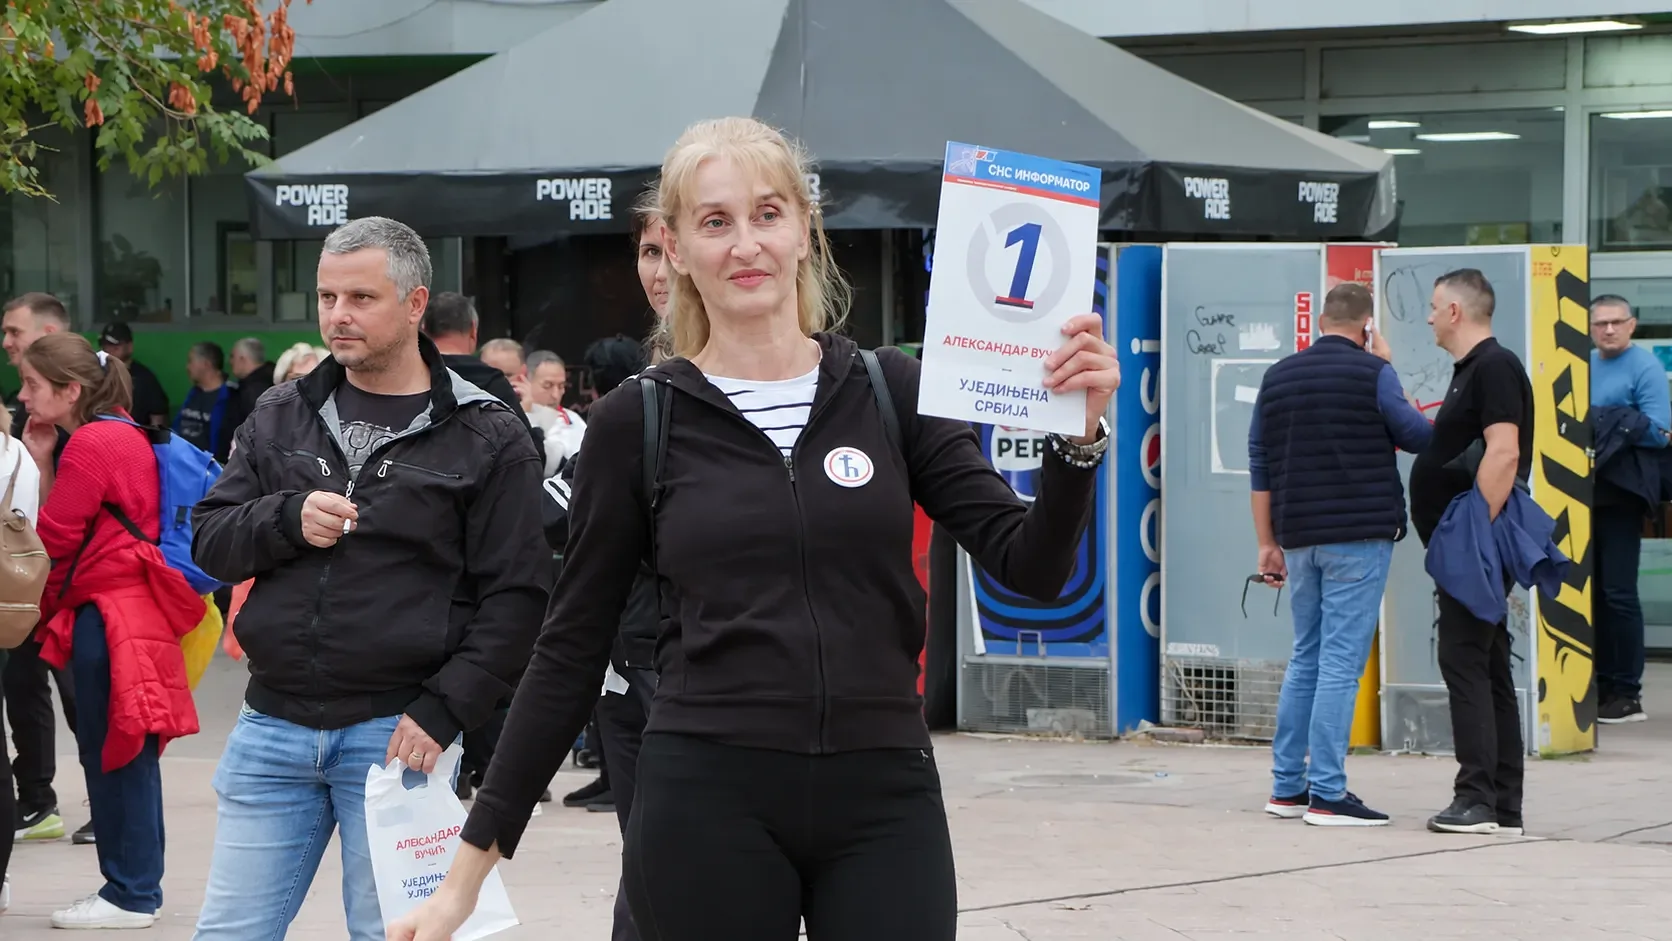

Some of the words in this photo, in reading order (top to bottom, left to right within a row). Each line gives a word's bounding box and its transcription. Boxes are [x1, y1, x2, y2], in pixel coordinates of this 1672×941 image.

[988, 164, 1012, 178] СНС
[1015, 169, 1091, 192] ИНФОРМАТОР
[1184, 177, 1229, 198] POWER
[276, 184, 349, 206] POWER
[536, 178, 612, 201] POWER
[1298, 182, 1339, 202] POWER
[308, 204, 348, 226] ADE
[570, 199, 612, 220] ADE
[1205, 199, 1231, 219] ADE
[1314, 203, 1337, 223] ADE
[995, 222, 1042, 309] 1
[943, 335, 1029, 357] АЛЕКСАНДАР
[1031, 348, 1052, 359] ВУЧ
[959, 378, 1049, 403] УЈЕДИЊЕНА
[974, 399, 1029, 418] СРБИЈА
[997, 438, 1044, 458] PEP
[401, 871, 448, 888] УЈЕДИЊ
